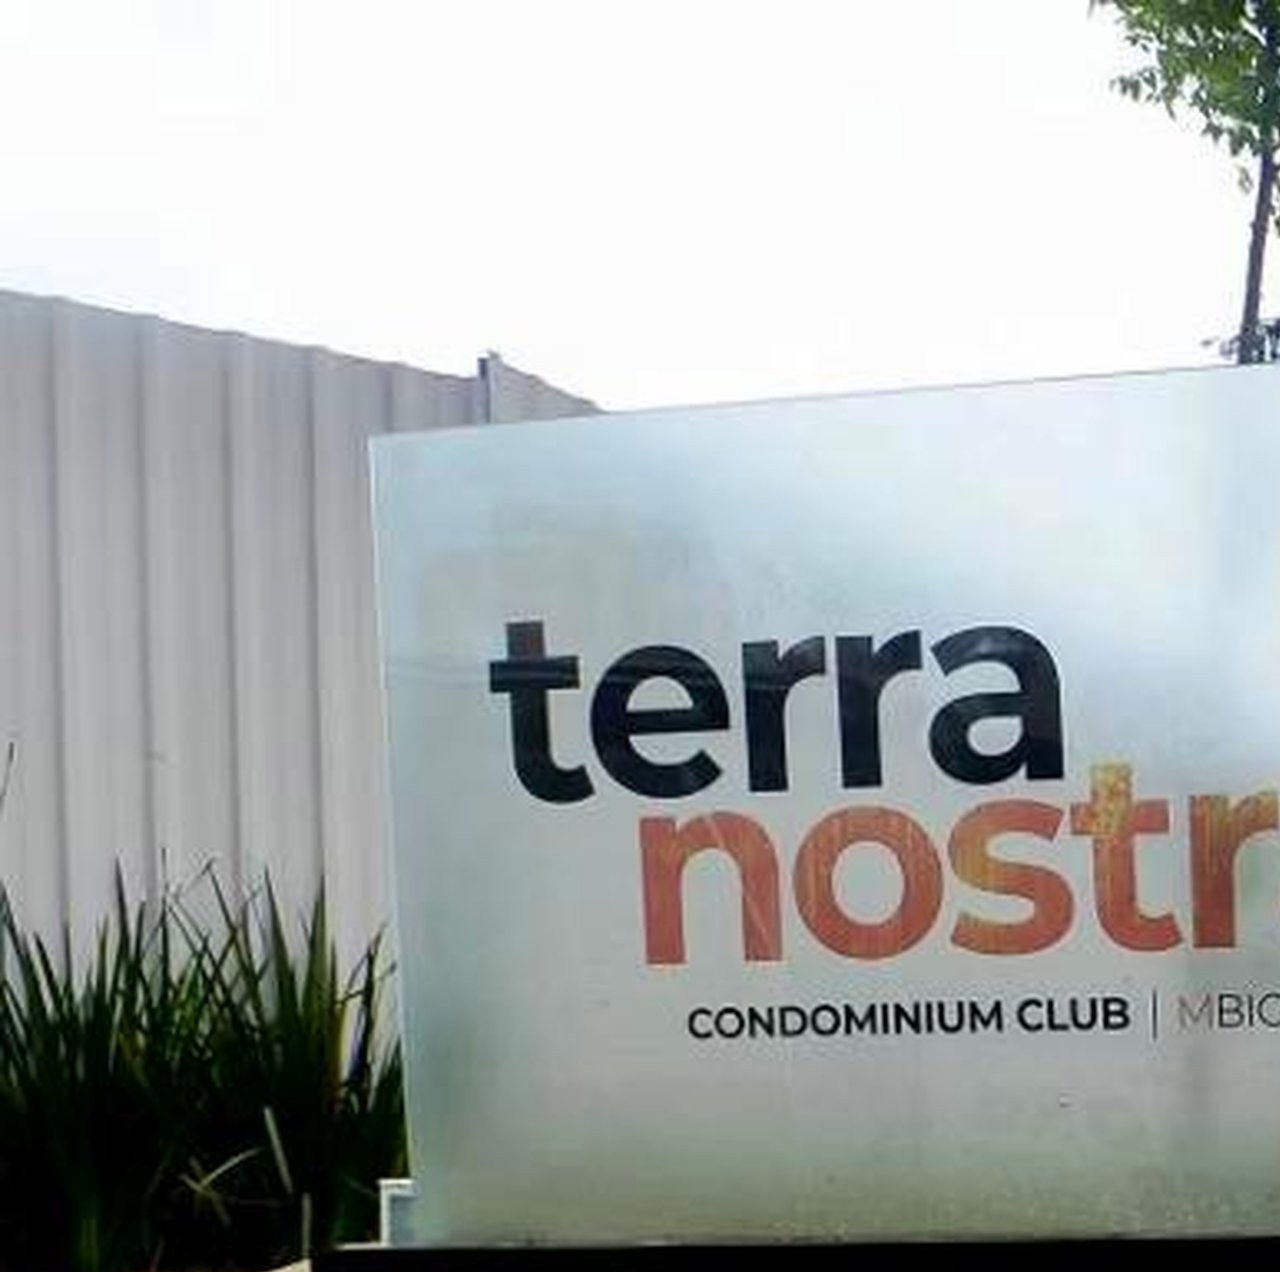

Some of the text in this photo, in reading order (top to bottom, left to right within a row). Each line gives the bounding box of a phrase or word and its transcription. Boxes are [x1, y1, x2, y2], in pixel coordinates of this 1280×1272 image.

[489, 620, 1066, 804] terra
[687, 998, 1003, 1040] CONDOMINIUM
[1016, 996, 1131, 1032] CLUB
